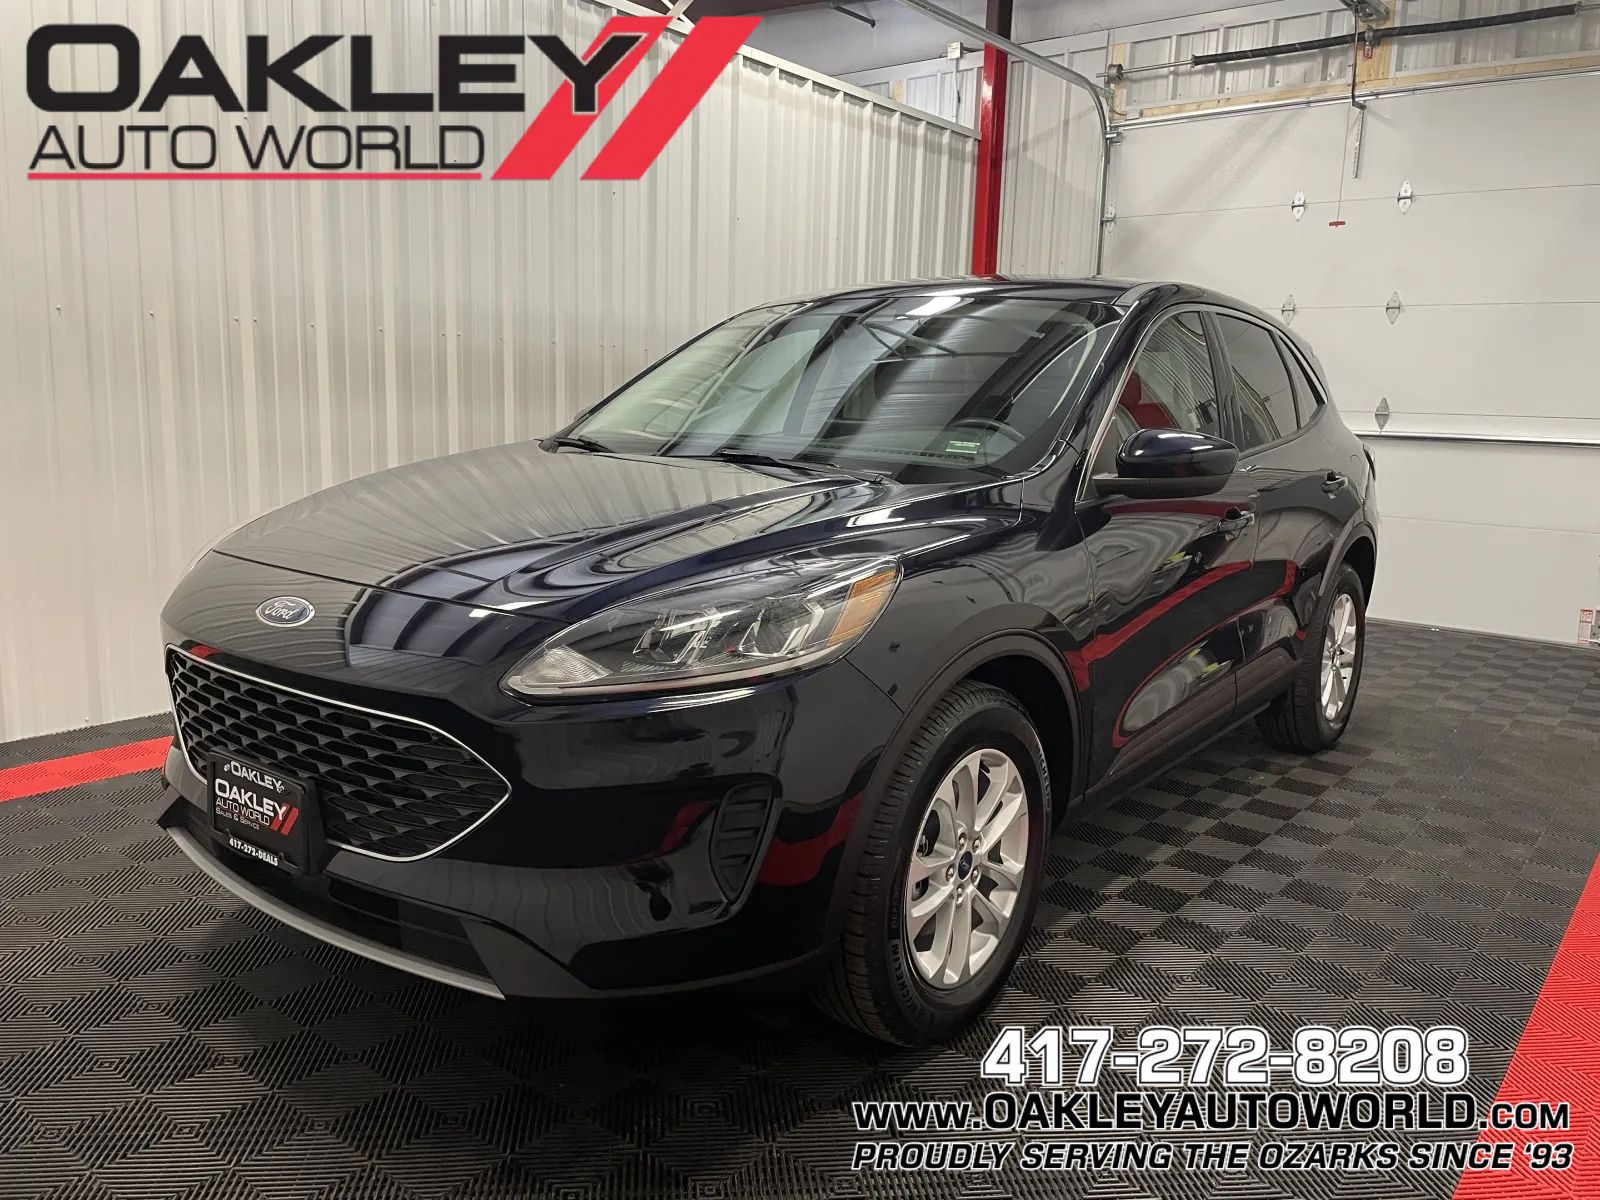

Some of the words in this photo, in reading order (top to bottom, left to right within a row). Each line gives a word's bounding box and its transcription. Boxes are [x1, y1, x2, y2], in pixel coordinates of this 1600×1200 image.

[264, 600, 300, 620] Ford
[230, 760, 283, 792] OAKLEY
[215, 778, 287, 821] OAKLEY
[215, 797, 240, 813] AUTO
[240, 805, 270, 826] WORLD
[229, 837, 279, 867] 417-272-DEALS
